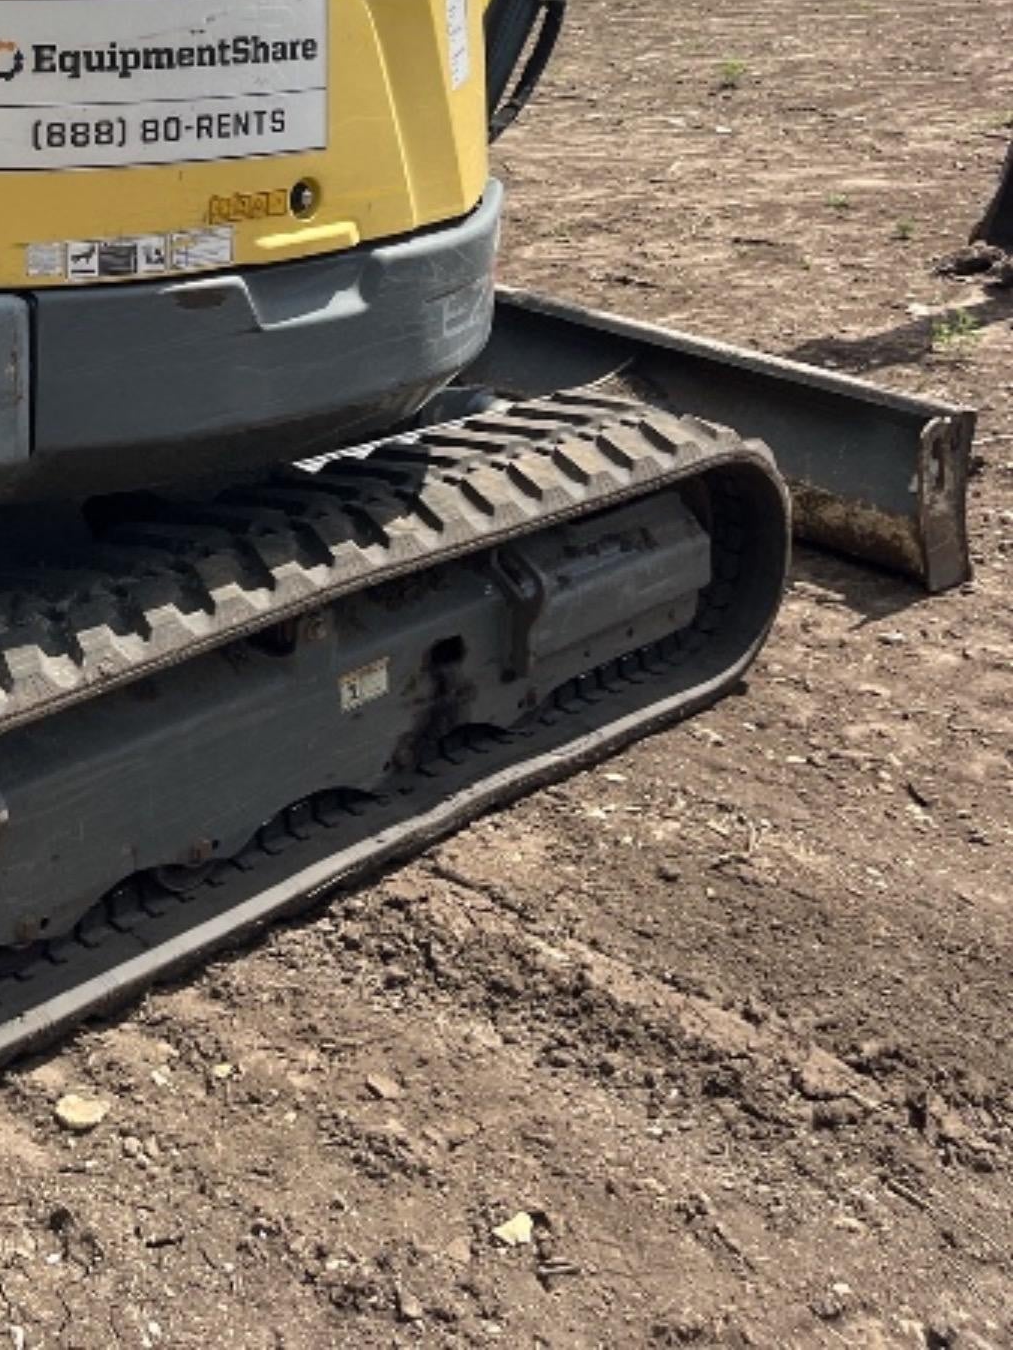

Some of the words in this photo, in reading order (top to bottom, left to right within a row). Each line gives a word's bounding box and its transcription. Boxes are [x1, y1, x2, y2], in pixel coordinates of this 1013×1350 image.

[32, 35, 318, 78] EquipmentShare
[31, 116, 126, 151] (888)
[141, 109, 286, 143] 80-RENTS
